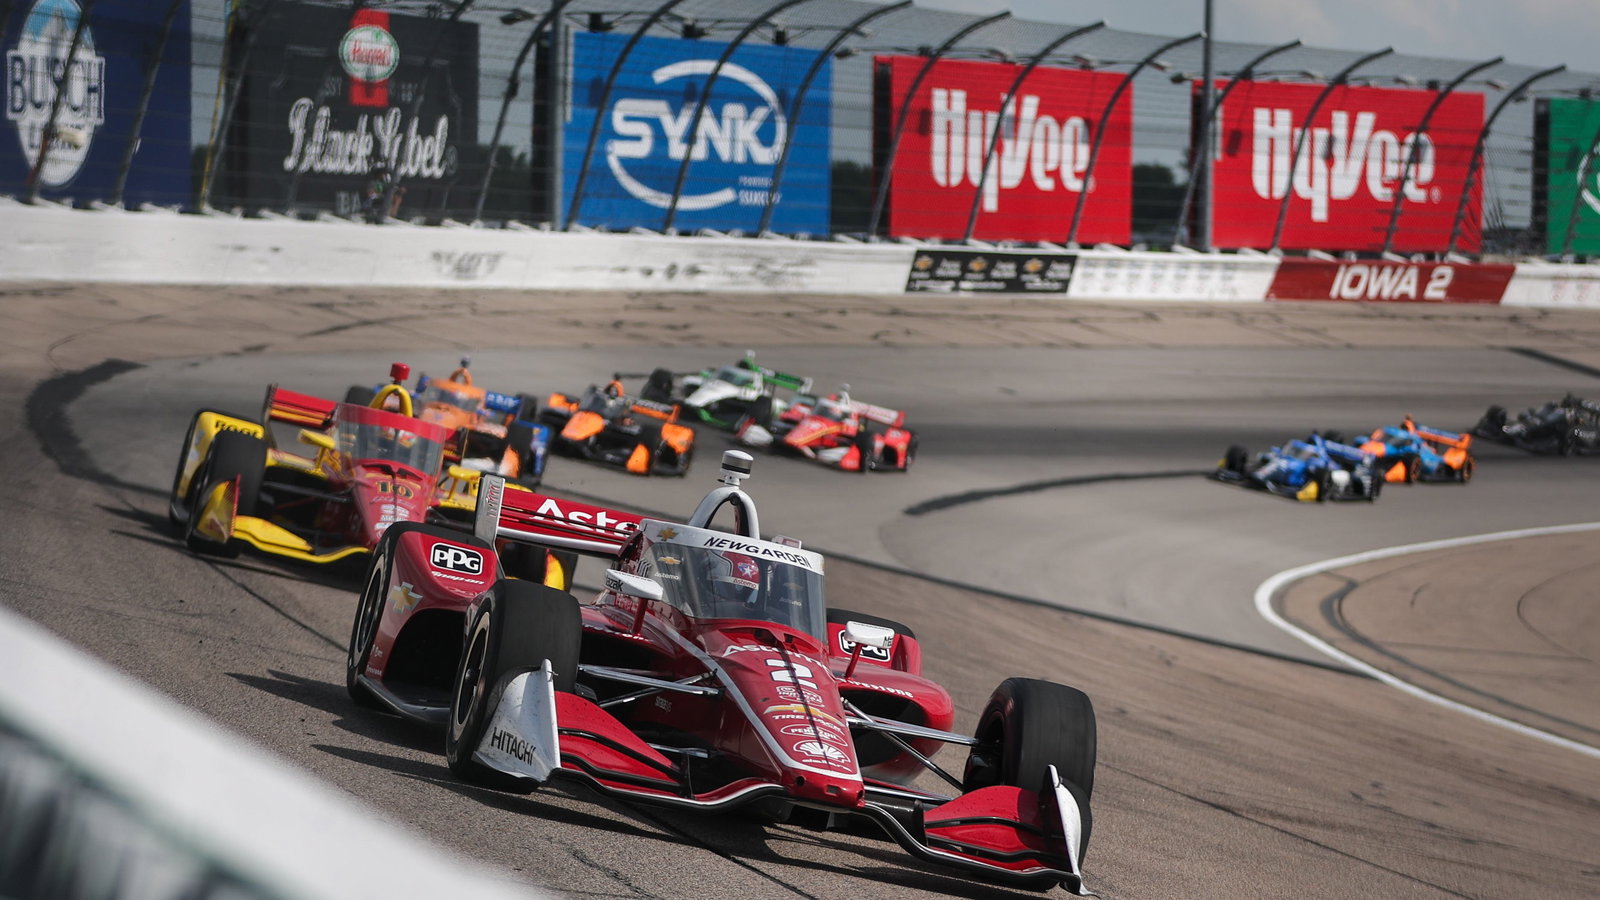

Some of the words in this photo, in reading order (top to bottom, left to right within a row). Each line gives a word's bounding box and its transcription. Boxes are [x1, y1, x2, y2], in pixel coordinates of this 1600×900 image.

[10, 56, 105, 119] BUSCH
[611, 98, 782, 165] SYNK
[1329, 264, 1420, 299] IOWA
[1423, 265, 1454, 300] 2
[433, 548, 480, 571] PPG
[704, 536, 812, 569] NEWGARDEN
[654, 571, 681, 581] Astemo
[765, 658, 819, 690] 2
[491, 726, 537, 767] HITACHI
